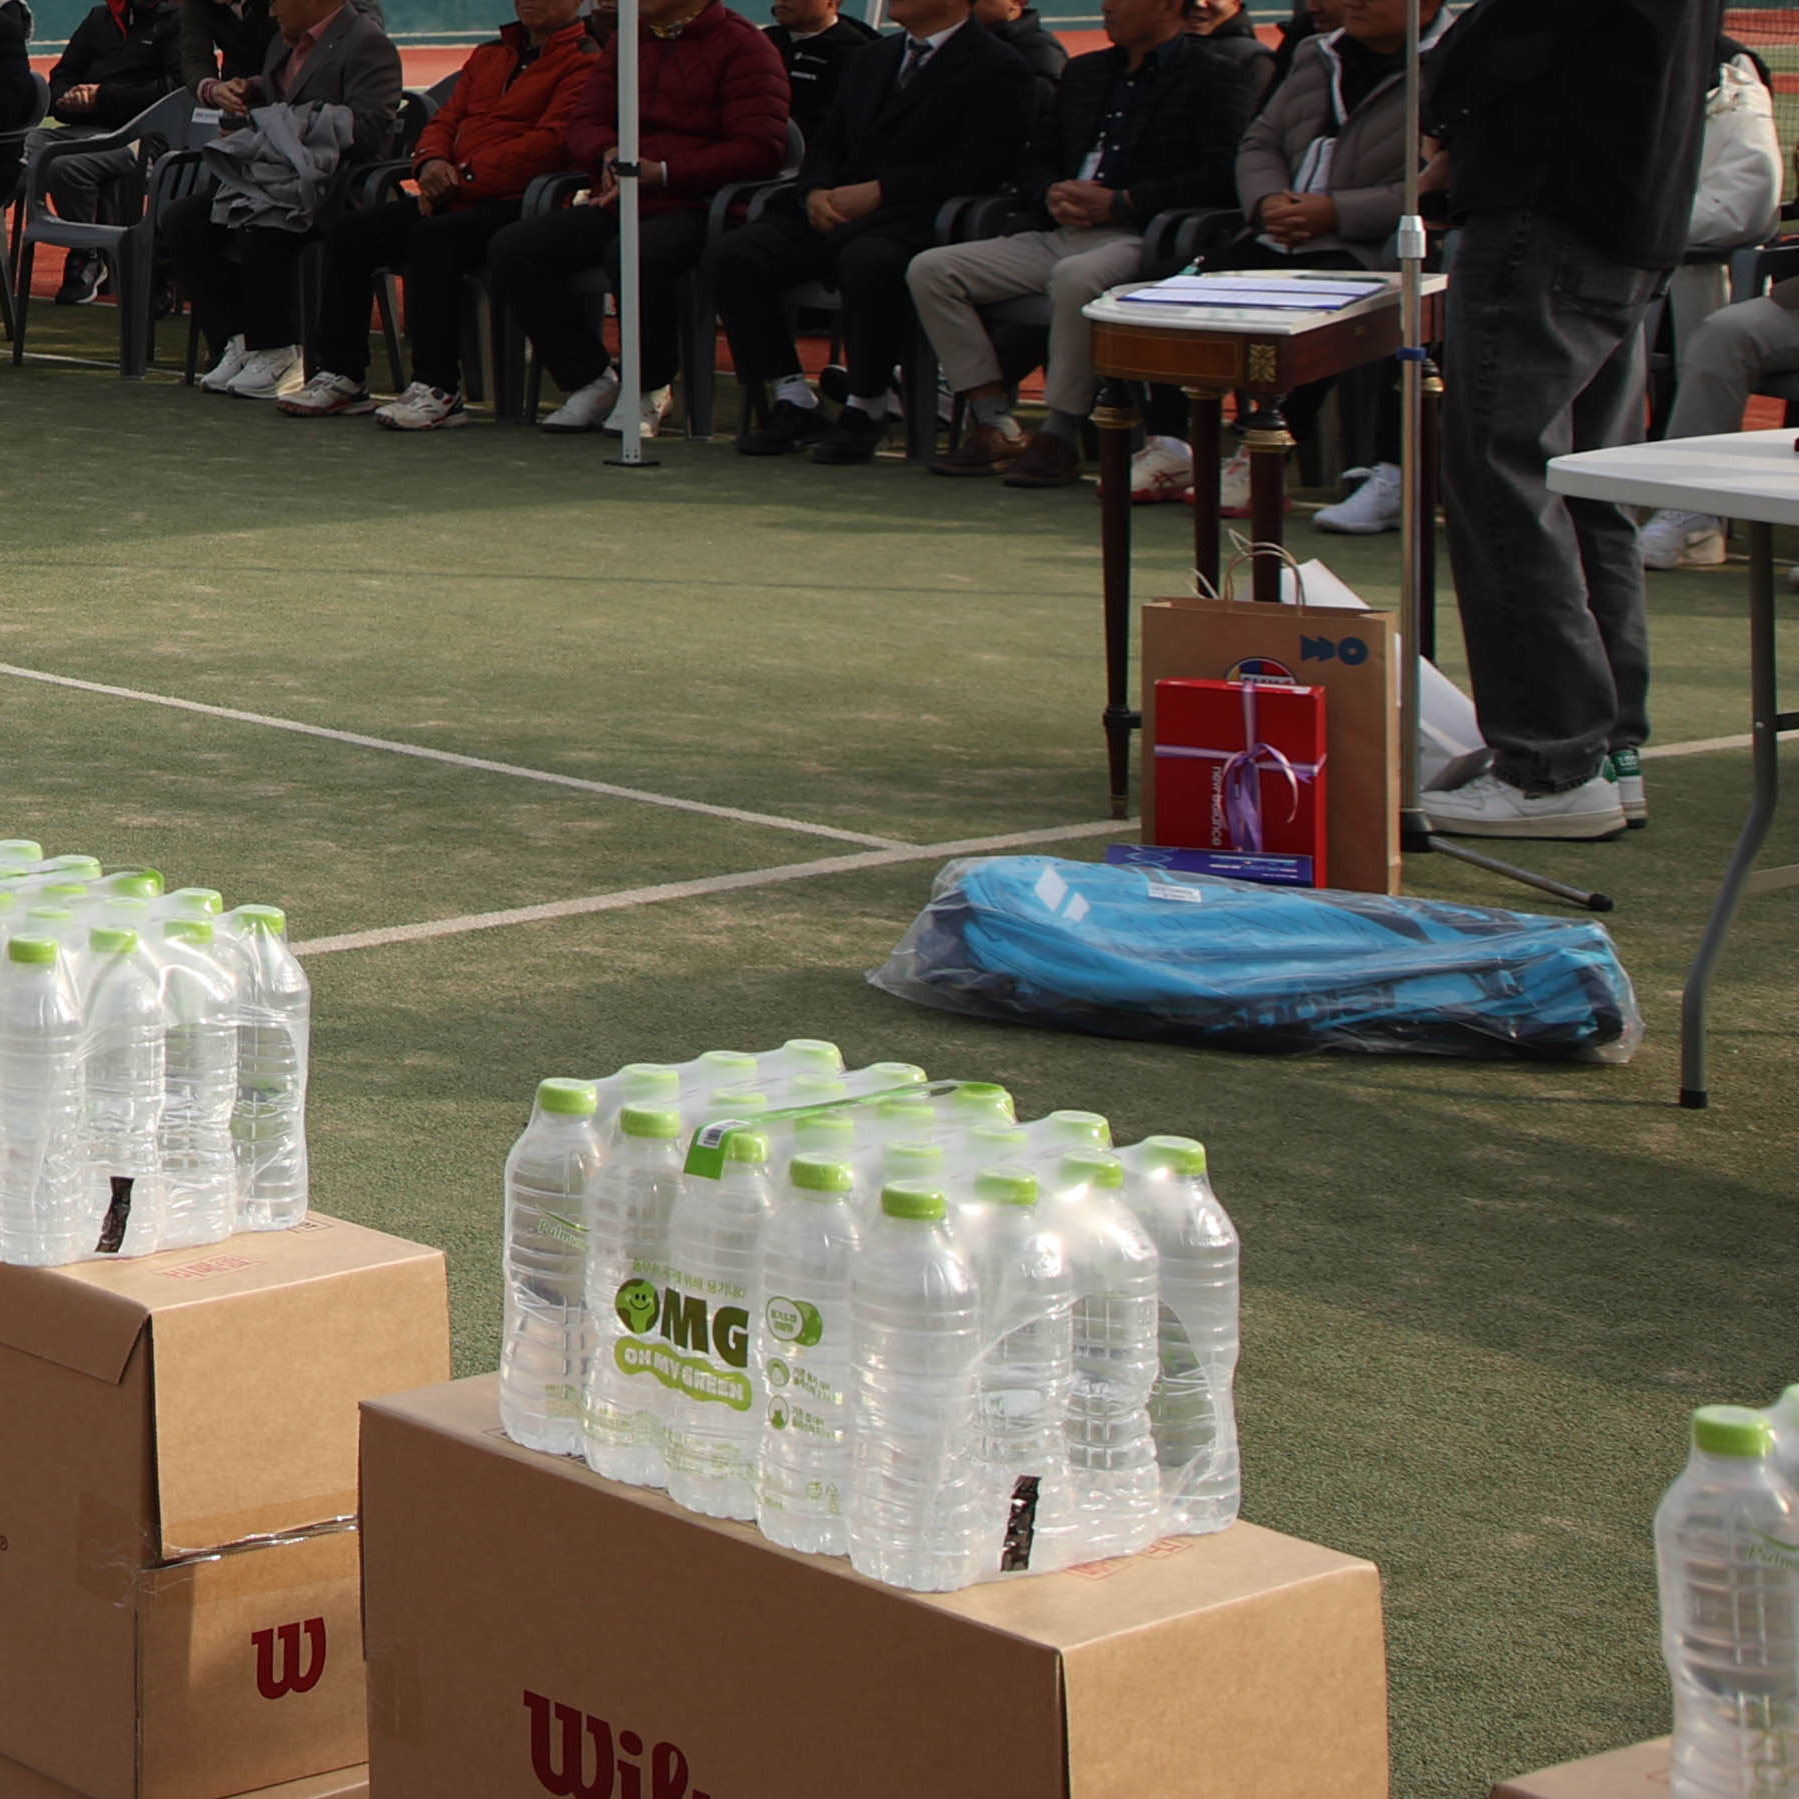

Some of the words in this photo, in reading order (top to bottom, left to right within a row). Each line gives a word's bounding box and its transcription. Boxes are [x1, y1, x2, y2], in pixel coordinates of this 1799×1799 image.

[614, 1277, 750, 1369] OMG
[623, 1346, 652, 1367] ON
[652, 1353, 685, 1381] MY
[682, 1364, 745, 1403] GREEN
[523, 1689, 712, 1799] Wil
